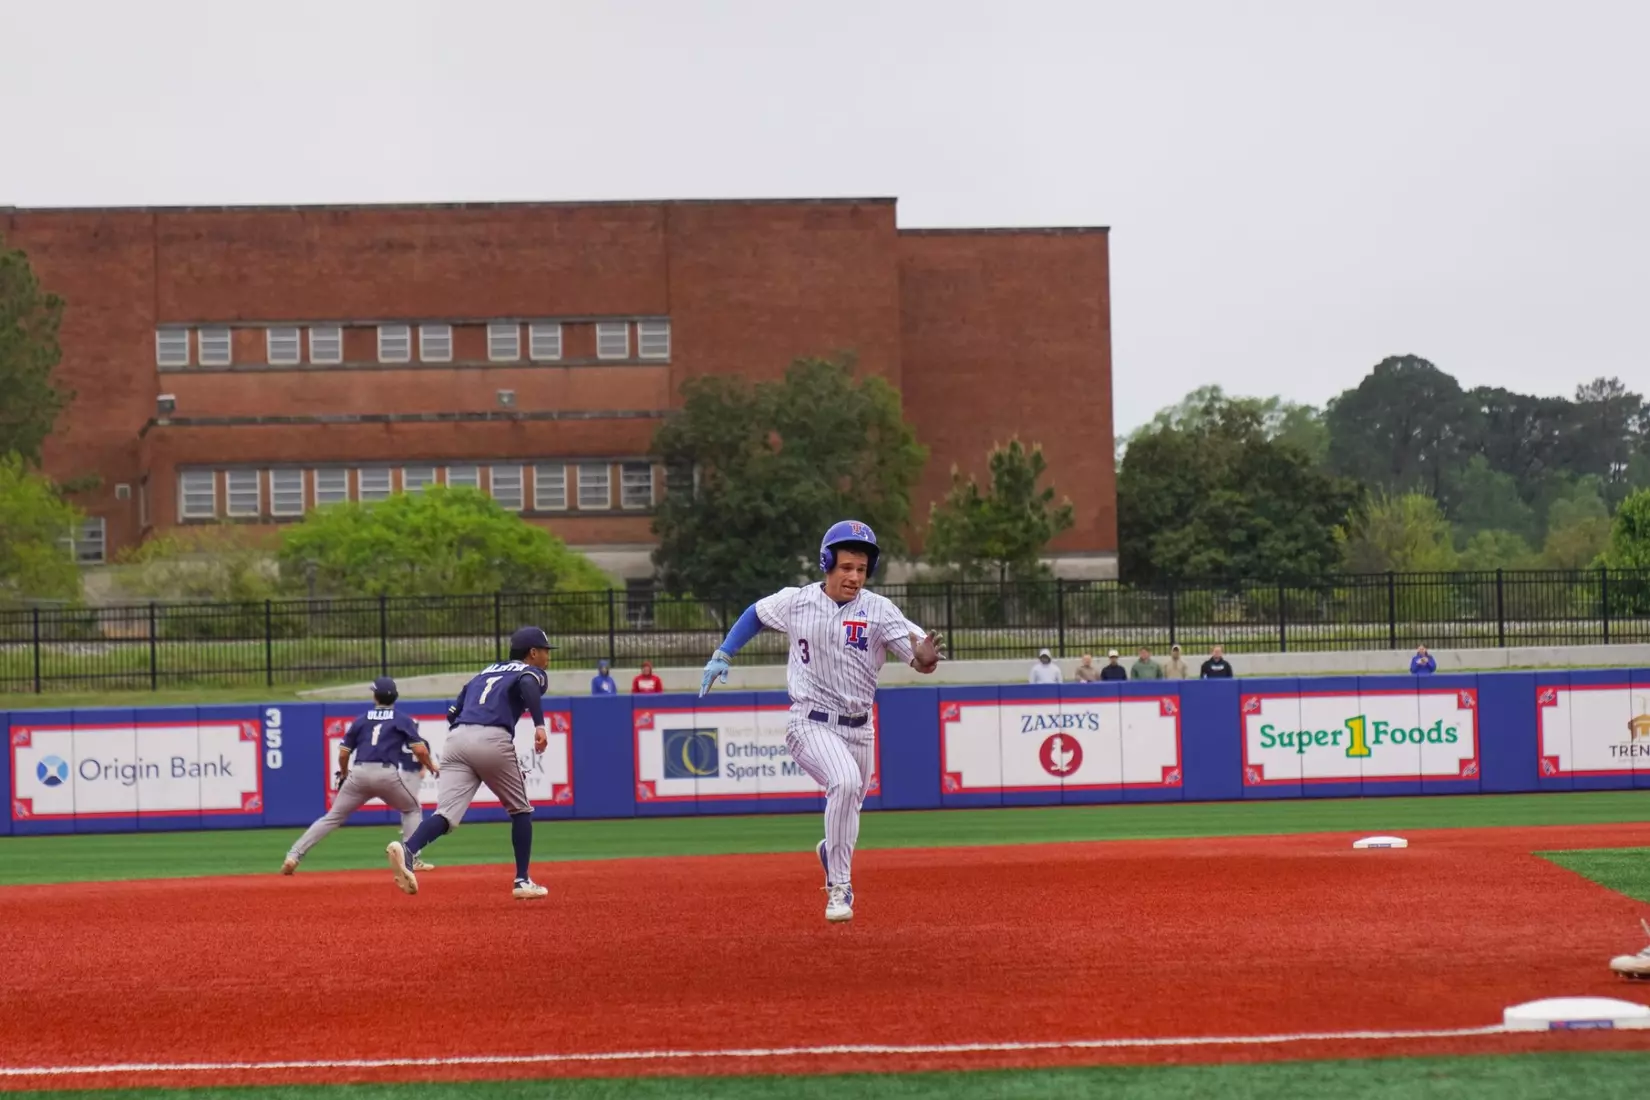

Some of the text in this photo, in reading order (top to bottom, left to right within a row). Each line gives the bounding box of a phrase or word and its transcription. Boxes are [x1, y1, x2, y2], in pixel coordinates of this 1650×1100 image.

[798, 638, 811, 665] 3
[371, 723, 382, 746] 1
[1022, 710, 1100, 734] ZAXBY'S
[266, 708, 282, 769] 350
[1259, 714, 1459, 758] Super 1 Foods
[726, 742, 791, 761] Orthopa
[79, 753, 234, 787] Origin Bank
[726, 763, 776, 782] Sports
